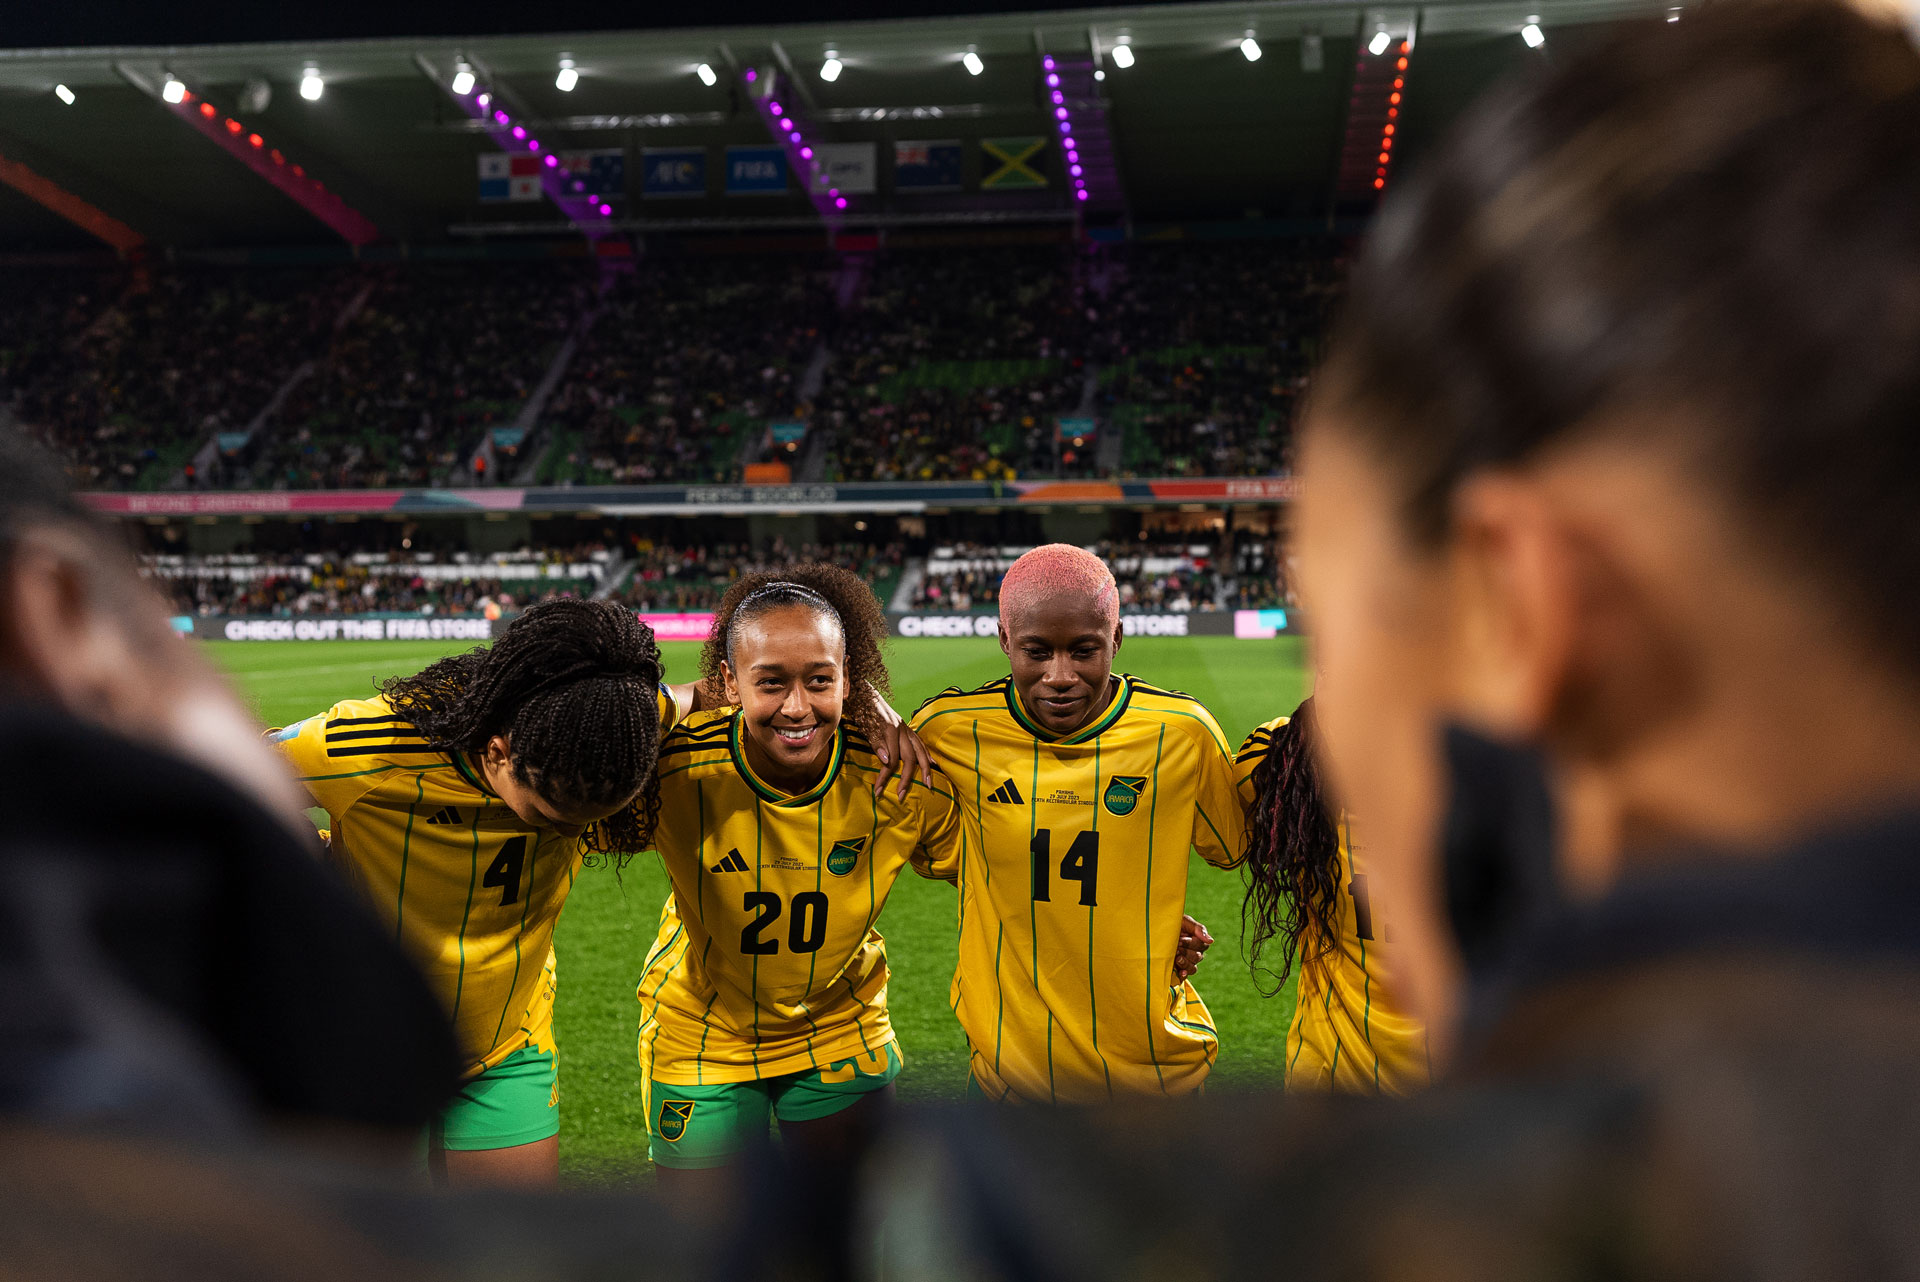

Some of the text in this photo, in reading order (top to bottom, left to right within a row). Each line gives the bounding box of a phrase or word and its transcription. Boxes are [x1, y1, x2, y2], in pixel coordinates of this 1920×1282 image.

[733, 161, 778, 180] FIFA
[1227, 481, 1264, 497] FIFA
[225, 619, 491, 640] CHECK OUT THE FIFA STORE
[898, 616, 973, 636] CHECK
[1123, 615, 1188, 636] STORE
[1106, 794, 1134, 804] JAMAICA
[482, 835, 528, 907] 4
[829, 856, 855, 866] JAMAICA
[1030, 828, 1100, 906] 14
[740, 891, 829, 955] 20
